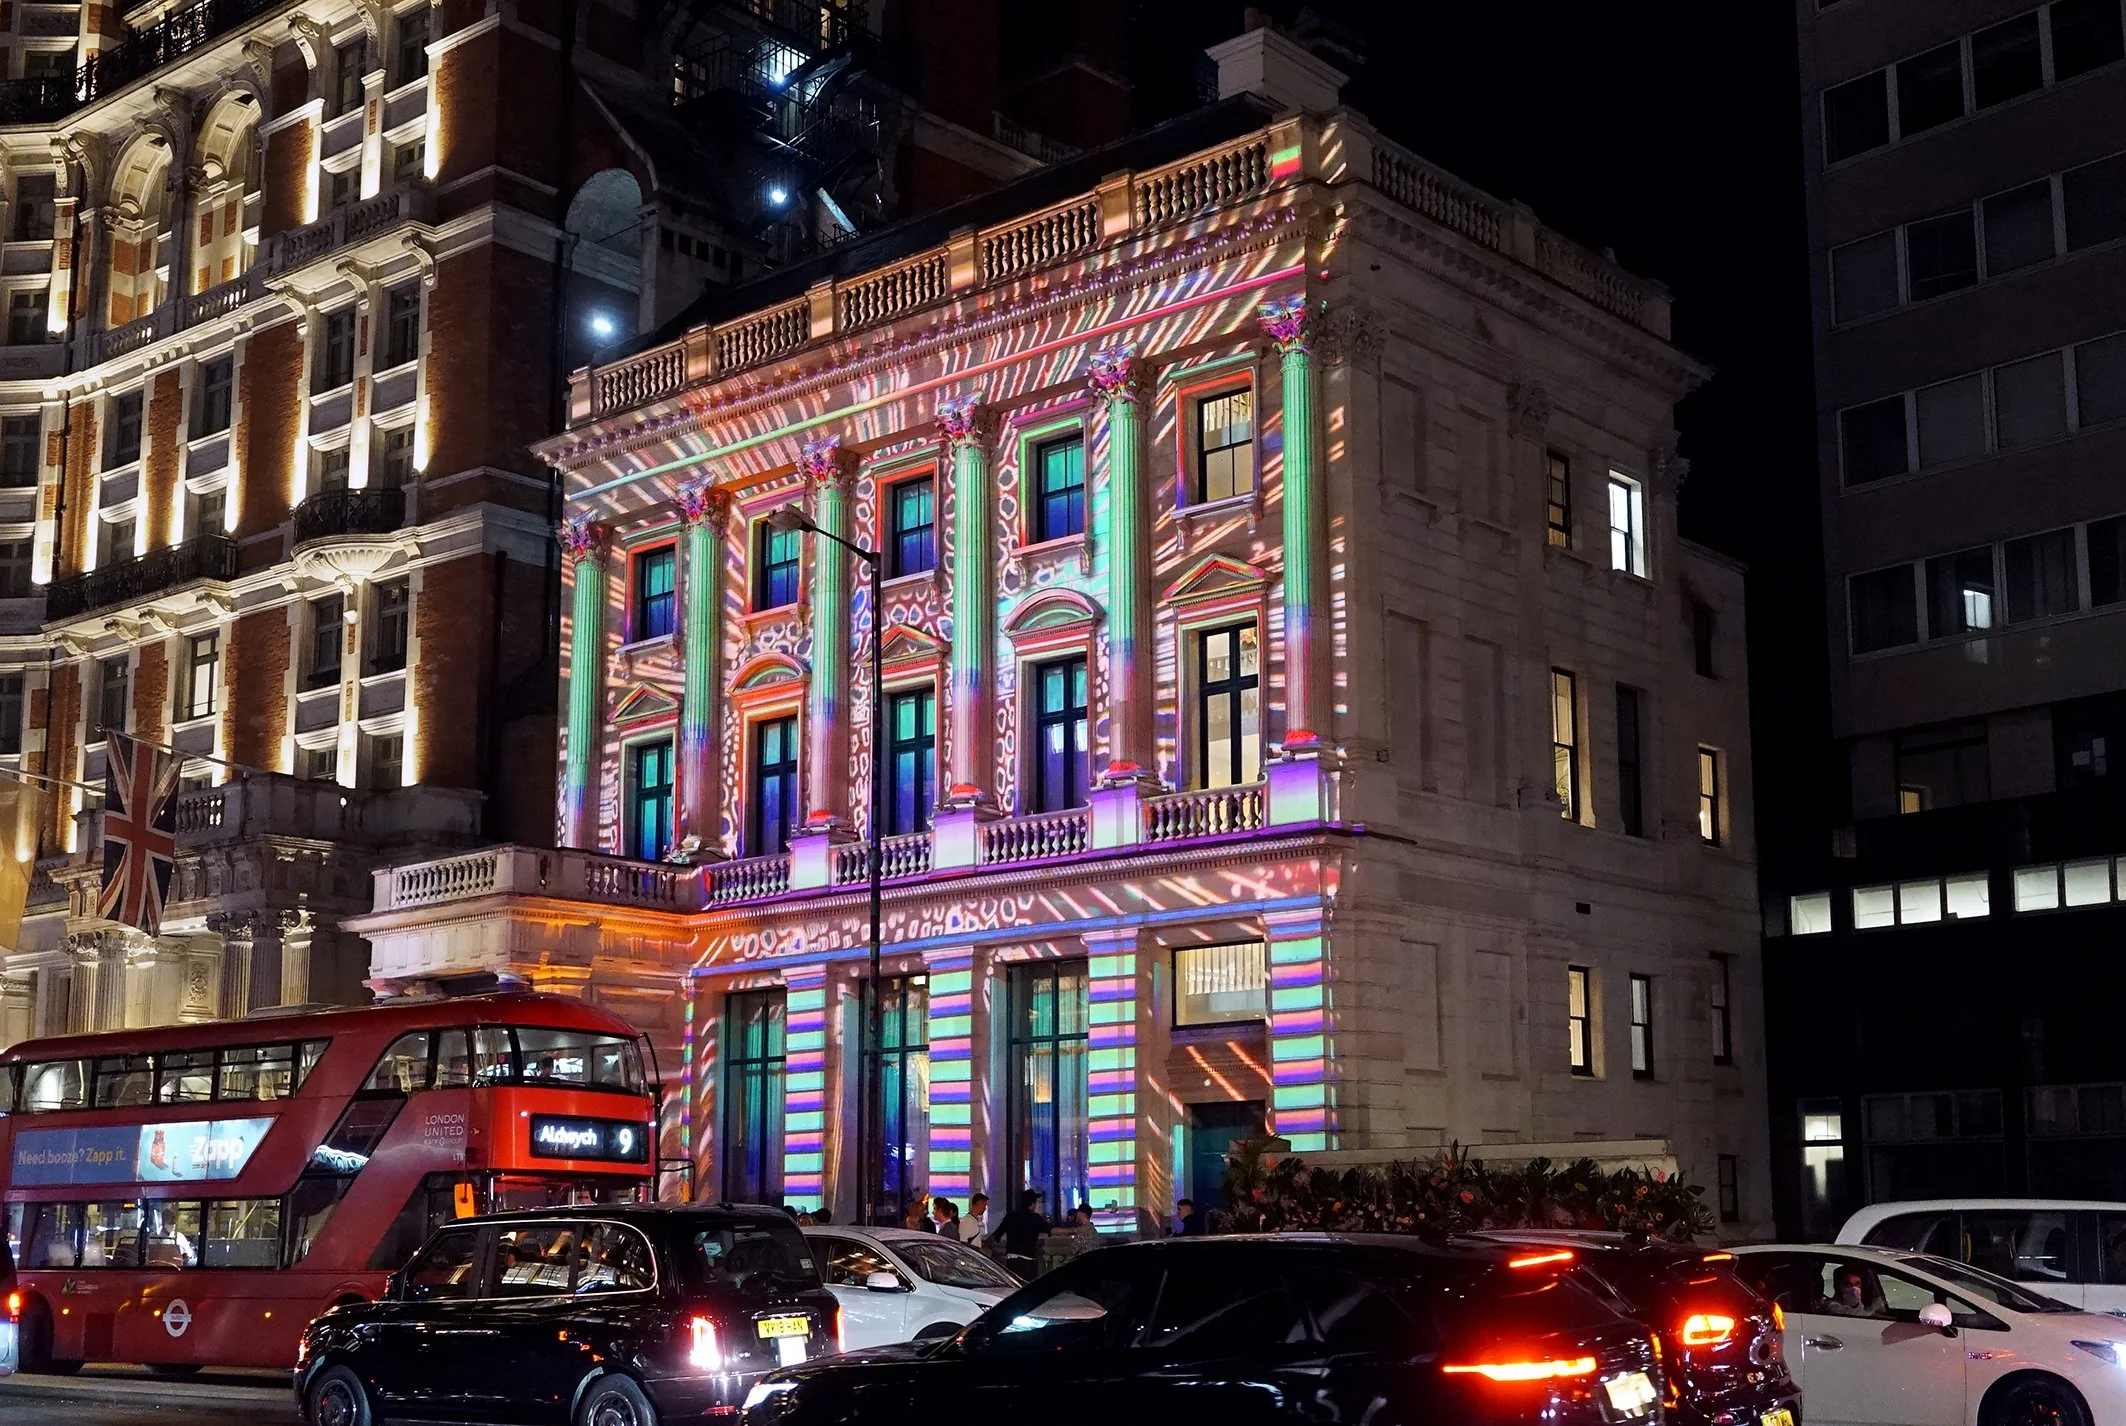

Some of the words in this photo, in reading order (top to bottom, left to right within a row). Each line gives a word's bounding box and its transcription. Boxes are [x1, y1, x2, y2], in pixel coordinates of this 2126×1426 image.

[425, 1114, 465, 1125] LONDON
[424, 1126, 464, 1137] UNITED
[540, 1125, 598, 1149] Aldwych
[619, 1128, 633, 1154] 9
[18, 1149, 46, 1166] Need
[47, 1148, 85, 1165] booze?
[86, 1146, 113, 1167] Zapp
[190, 1136, 244, 1170] Zapp
